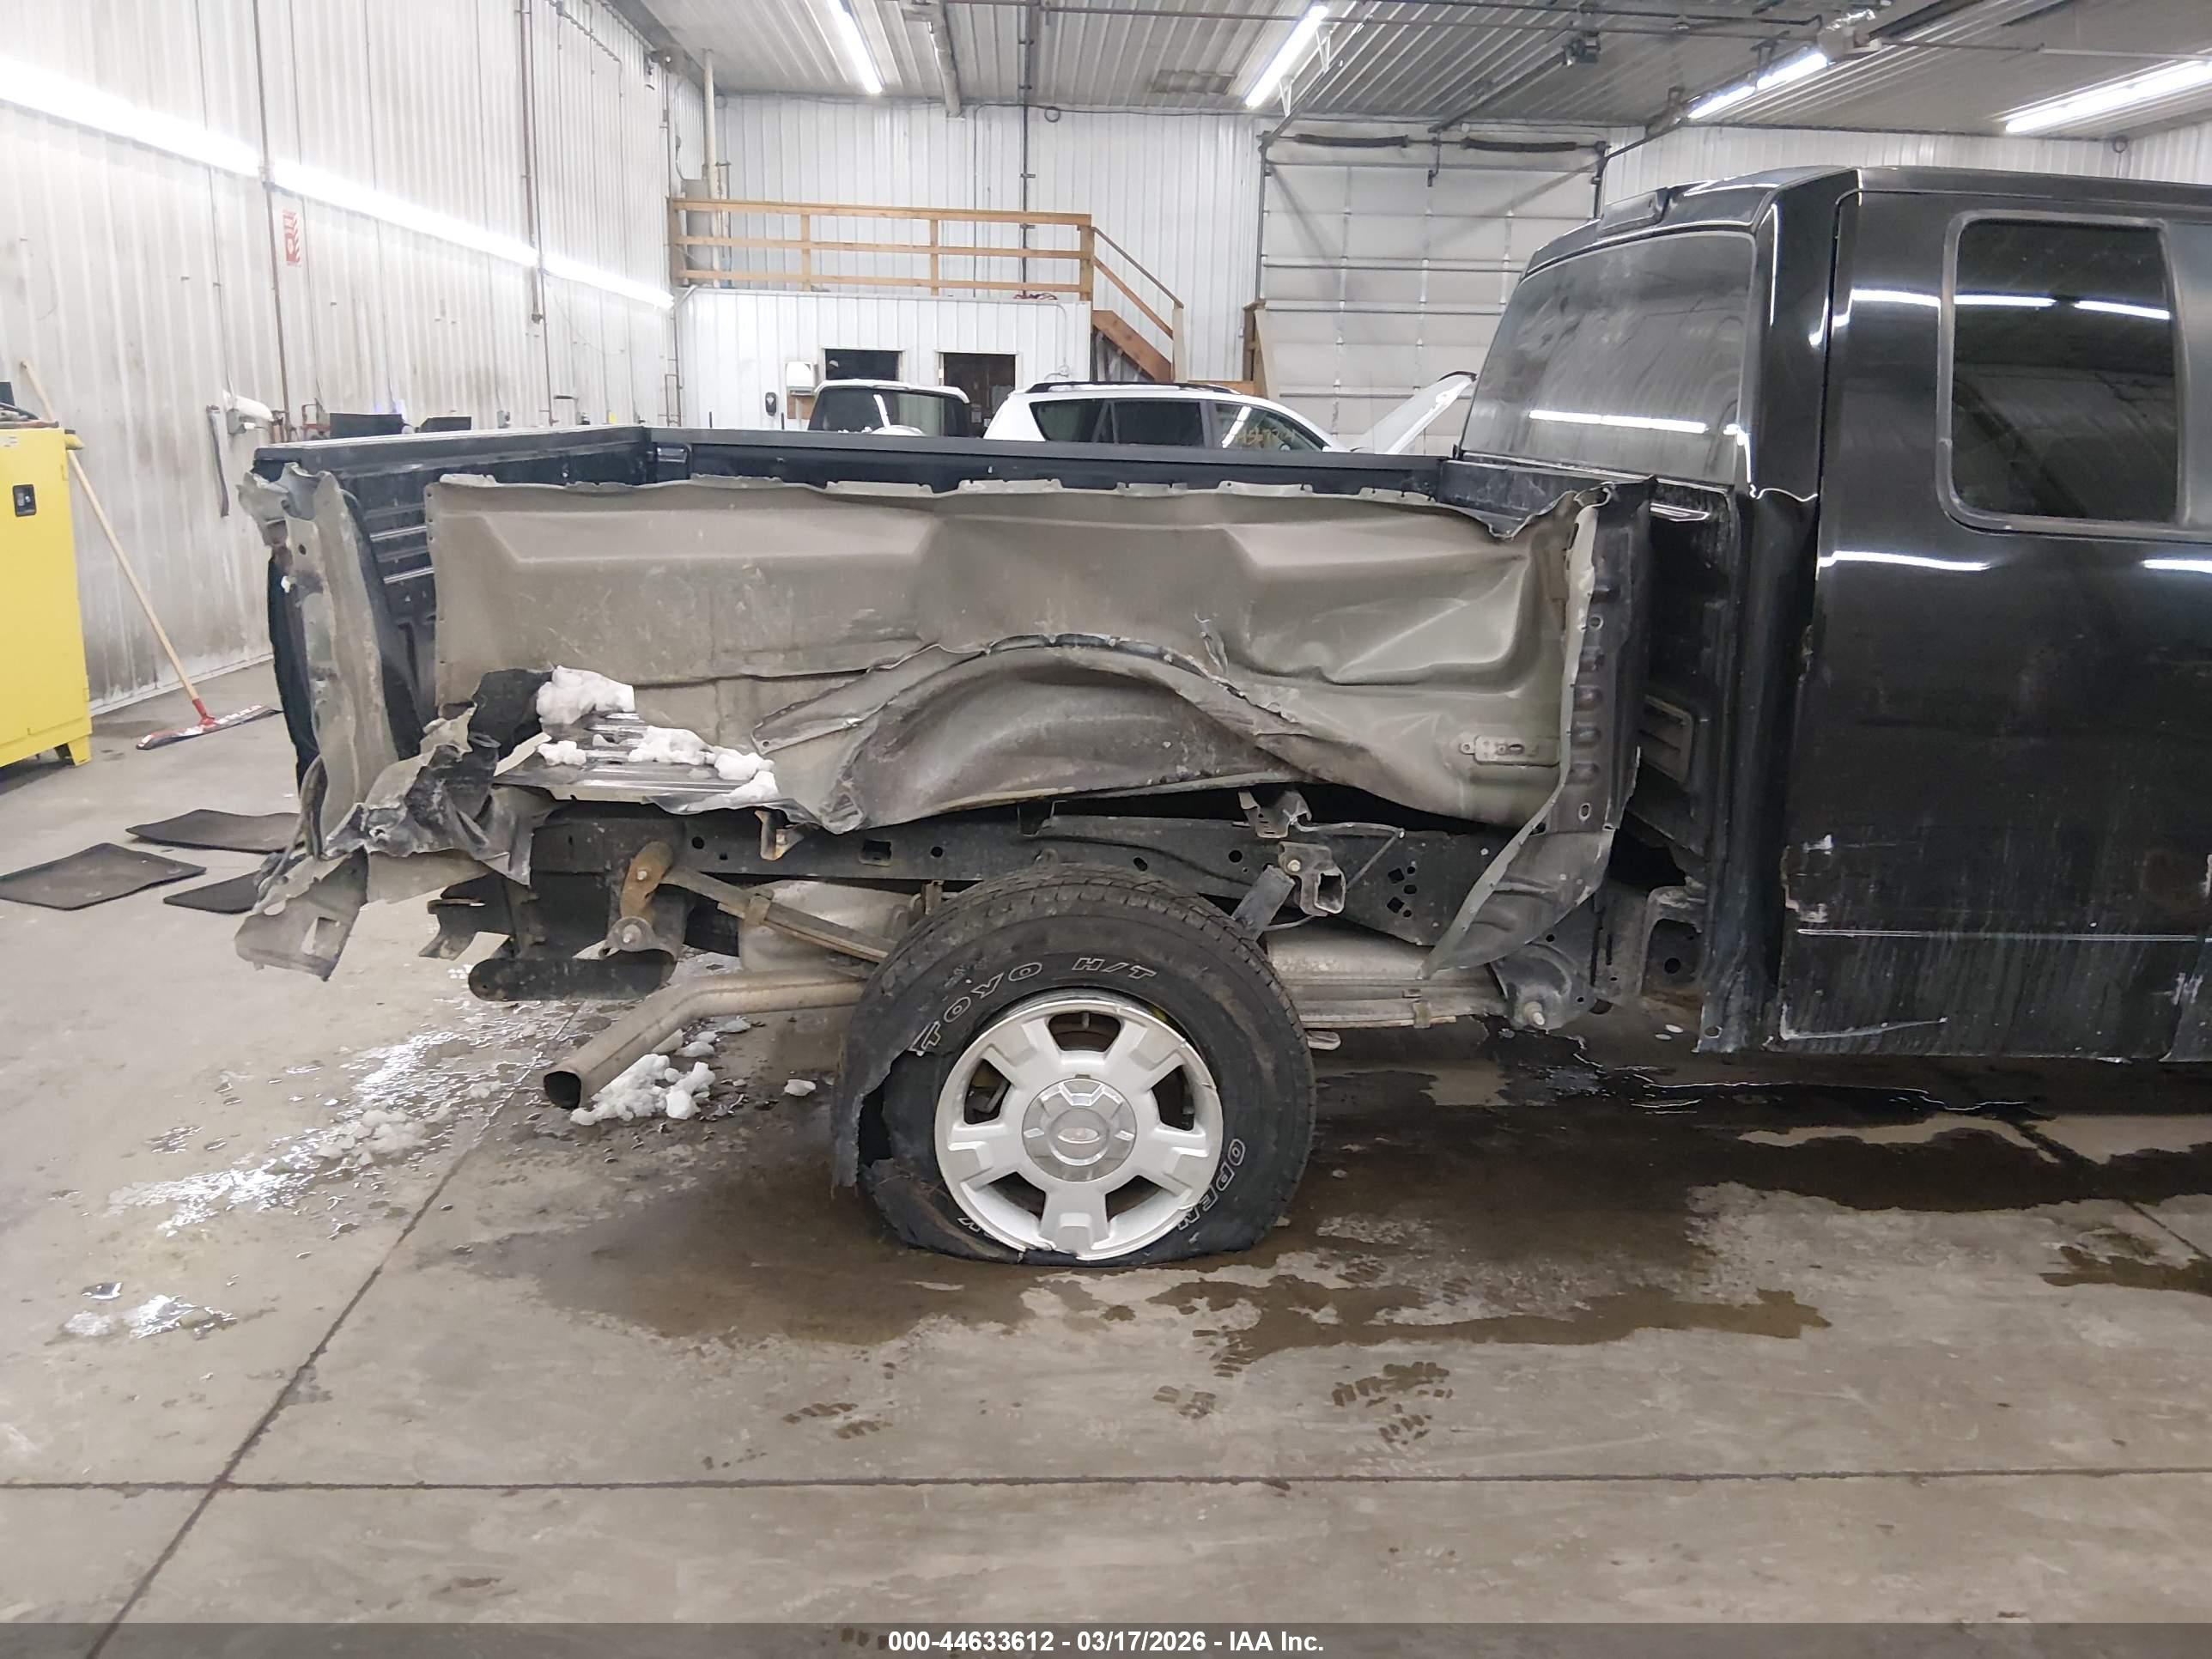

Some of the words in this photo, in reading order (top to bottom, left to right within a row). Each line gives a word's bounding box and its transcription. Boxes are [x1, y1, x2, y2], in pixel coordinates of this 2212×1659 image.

[908, 962, 1042, 1056] TOYO
[1071, 957, 1158, 980] H/T
[1177, 1139, 1246, 1231] OPEN
